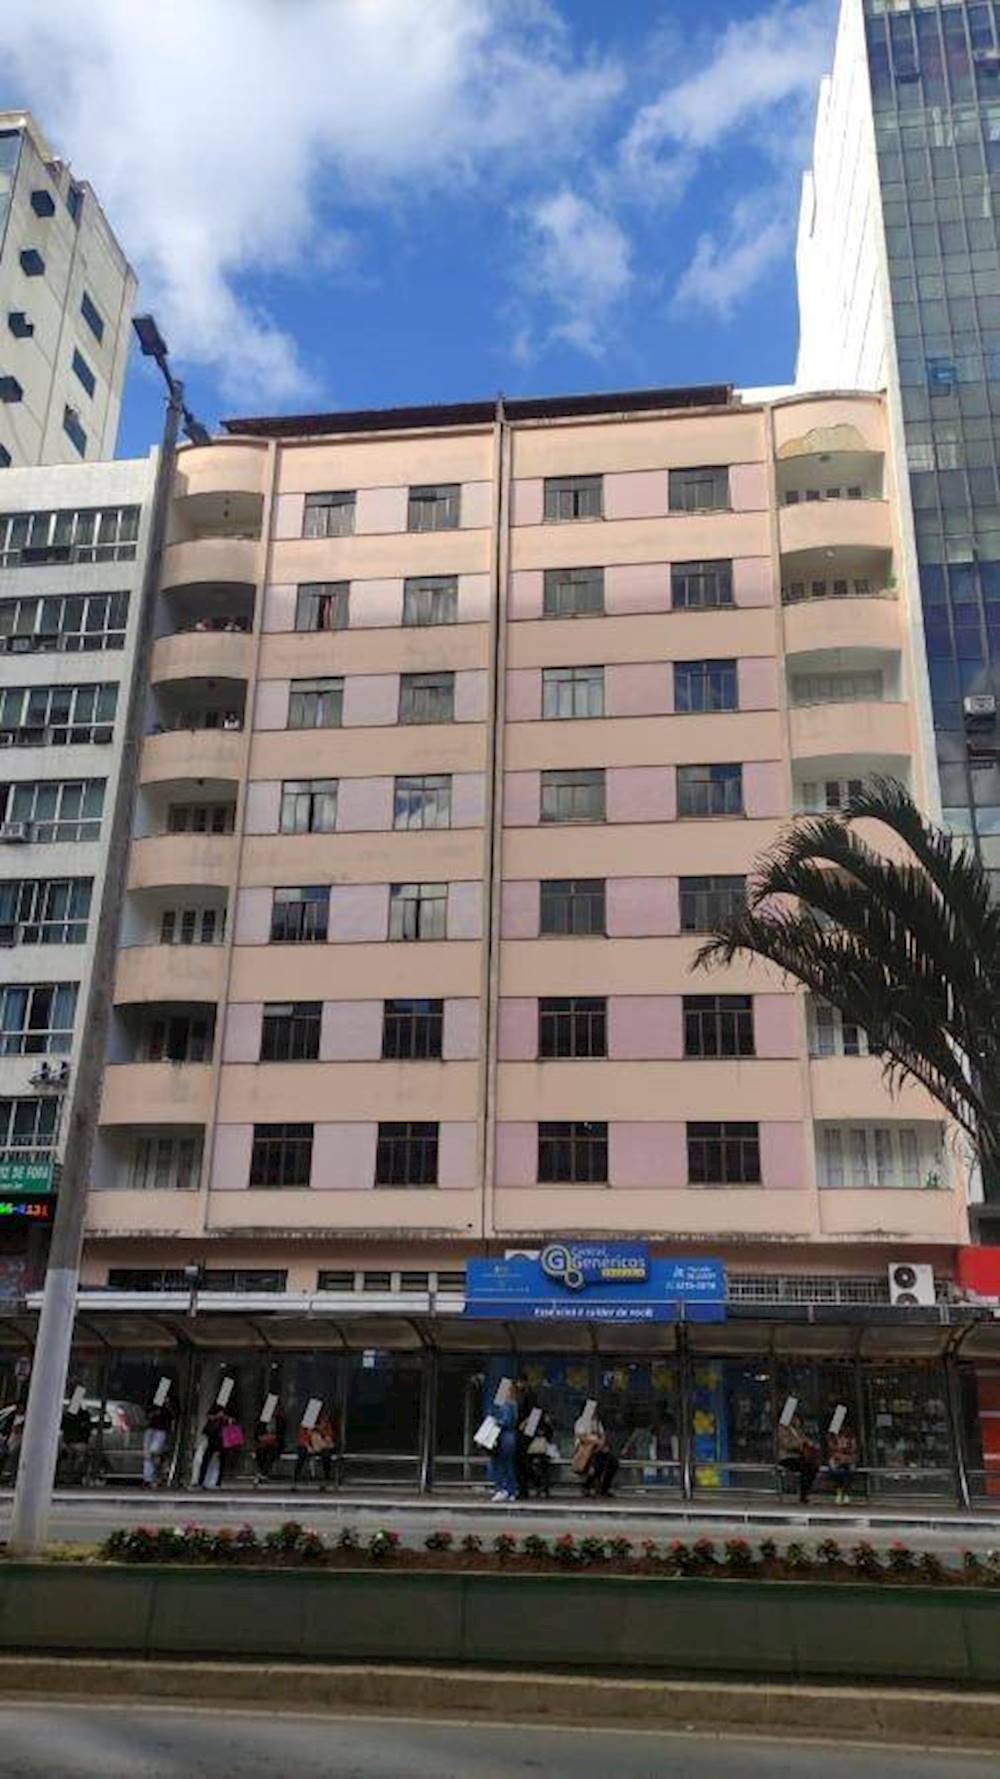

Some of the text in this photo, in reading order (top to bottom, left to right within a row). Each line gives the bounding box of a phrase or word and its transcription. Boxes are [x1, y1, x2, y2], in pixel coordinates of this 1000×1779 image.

[12, 1164, 25, 1178] DE
[571, 1245, 606, 1255] Central
[571, 1254, 646, 1270] Genéricos
